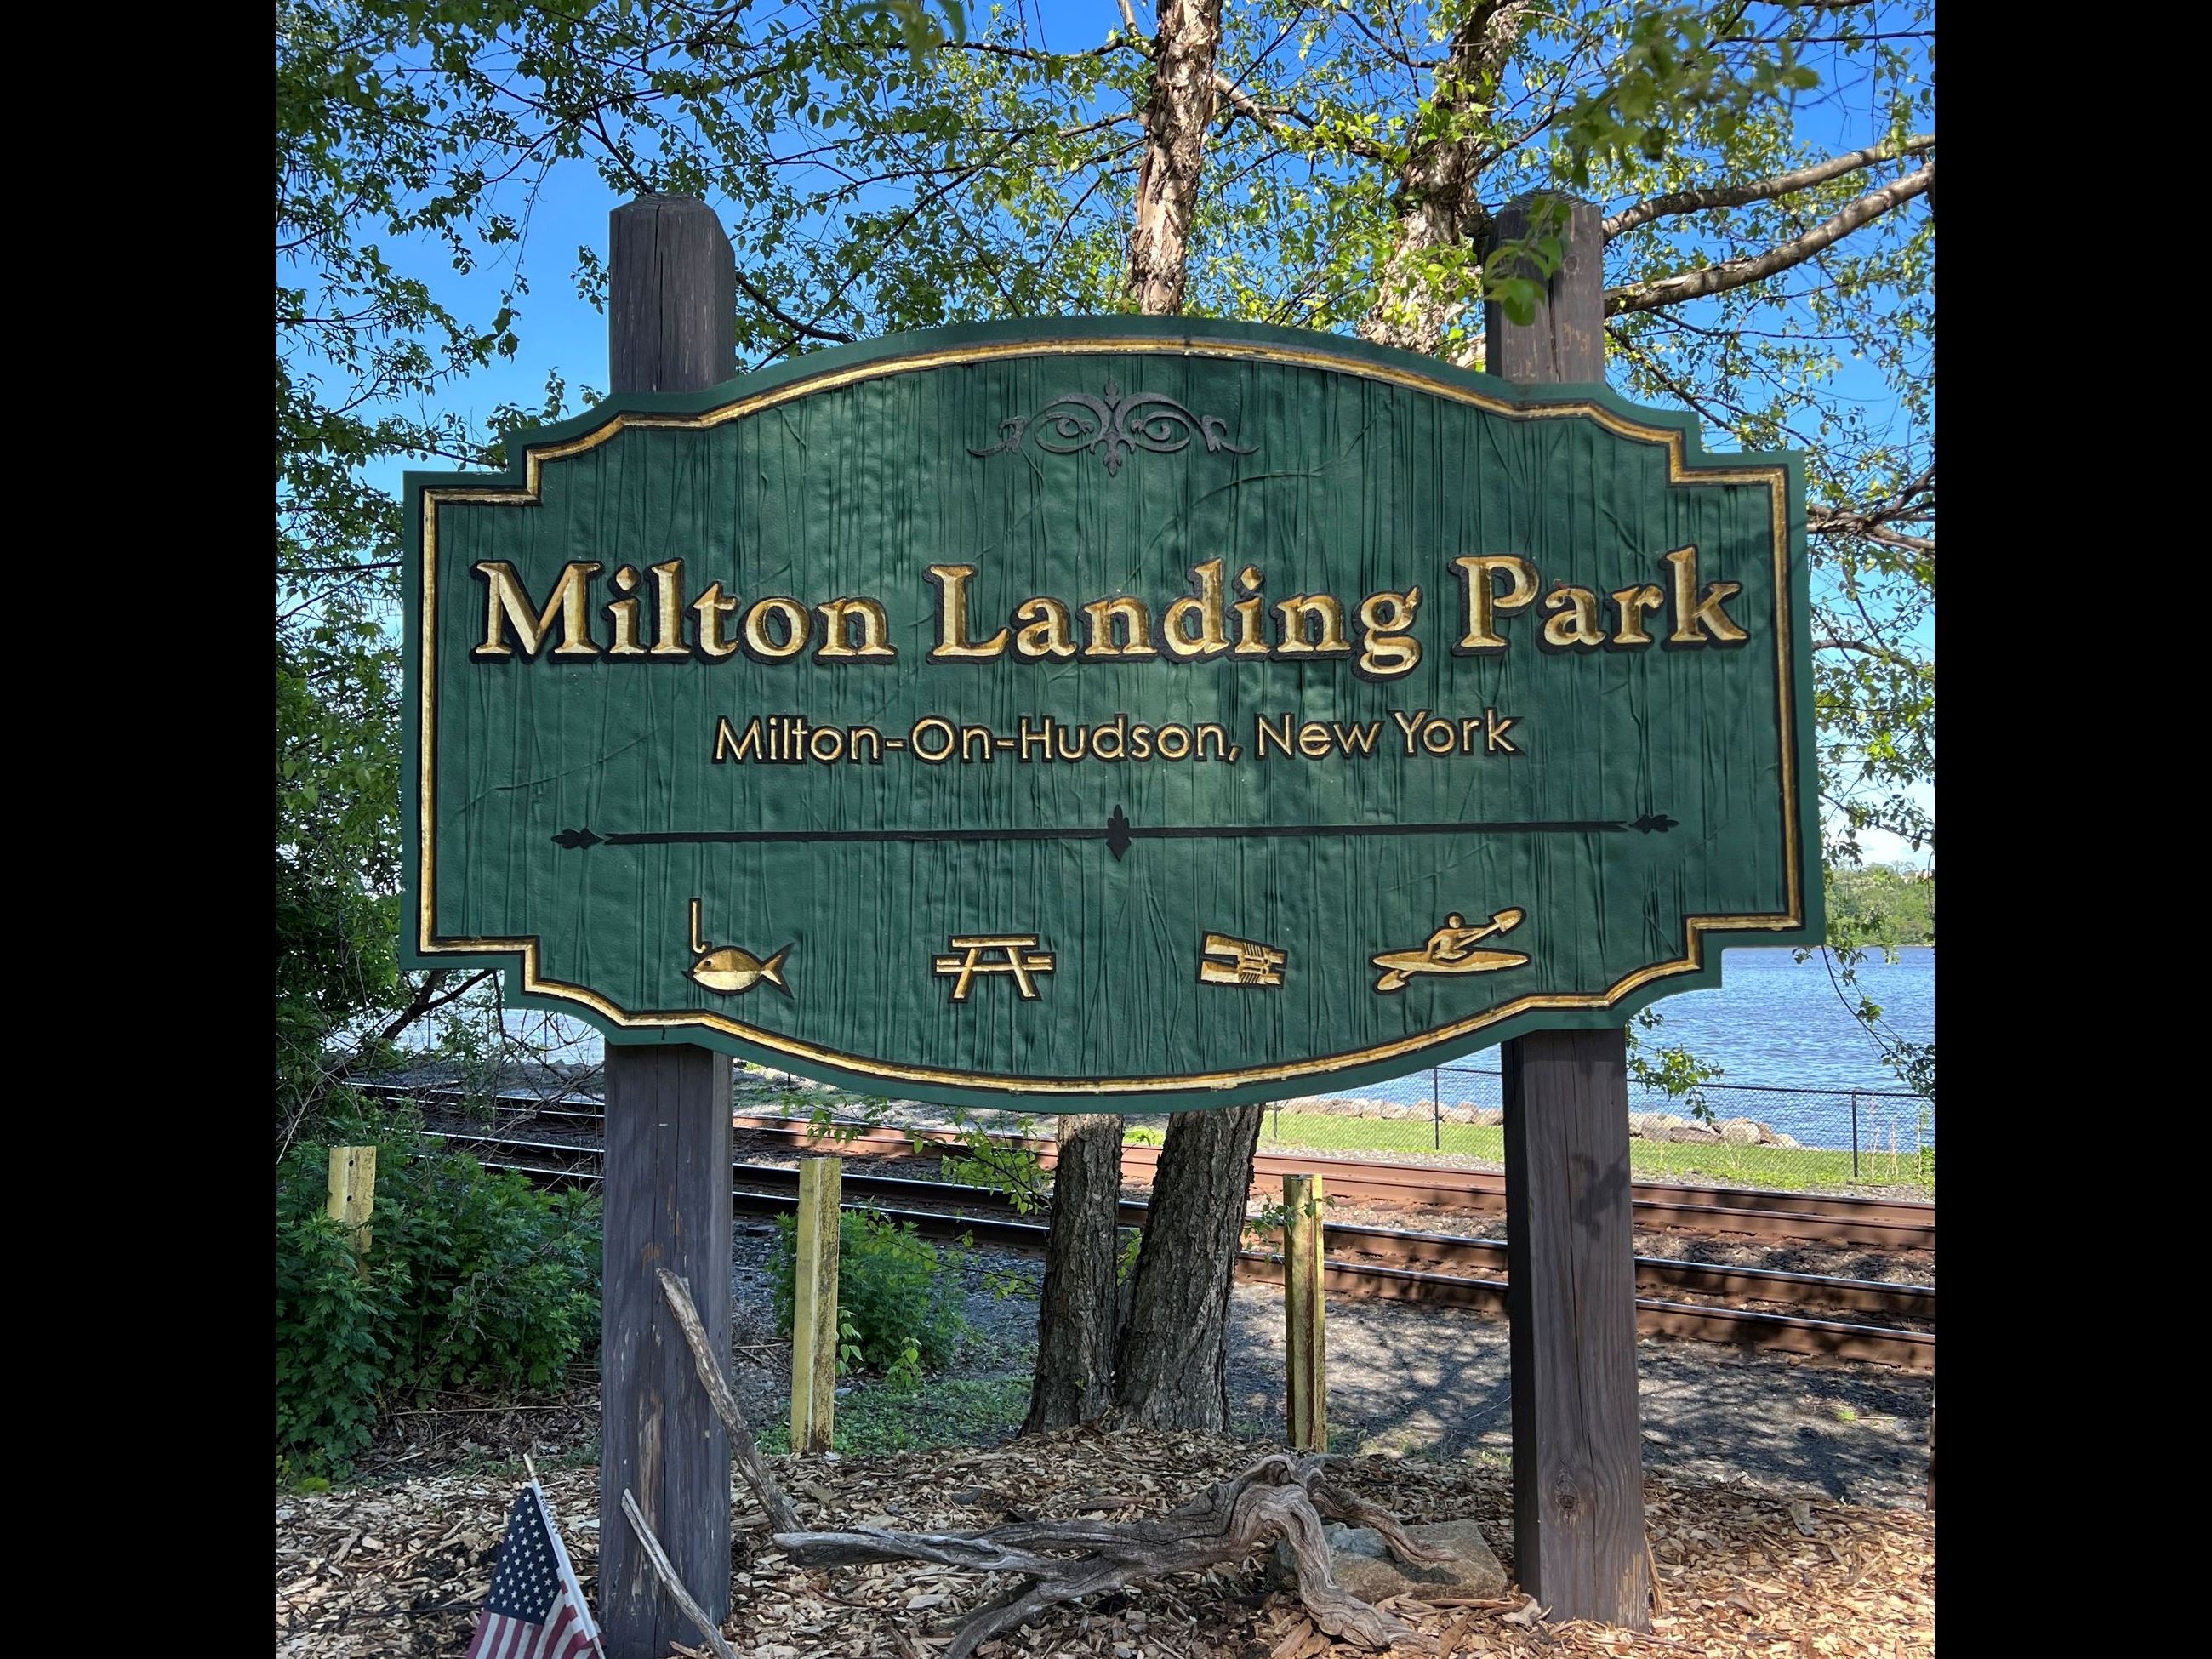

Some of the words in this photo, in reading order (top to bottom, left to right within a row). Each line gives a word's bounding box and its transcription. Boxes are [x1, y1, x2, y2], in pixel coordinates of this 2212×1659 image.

[473, 559, 897, 662] Milton
[929, 556, 1422, 678] Landing
[1453, 544, 1748, 651] Park
[714, 713, 1240, 762] Milton-On-Hudson,
[1257, 715, 1383, 758] New
[1392, 709, 1519, 758] York
